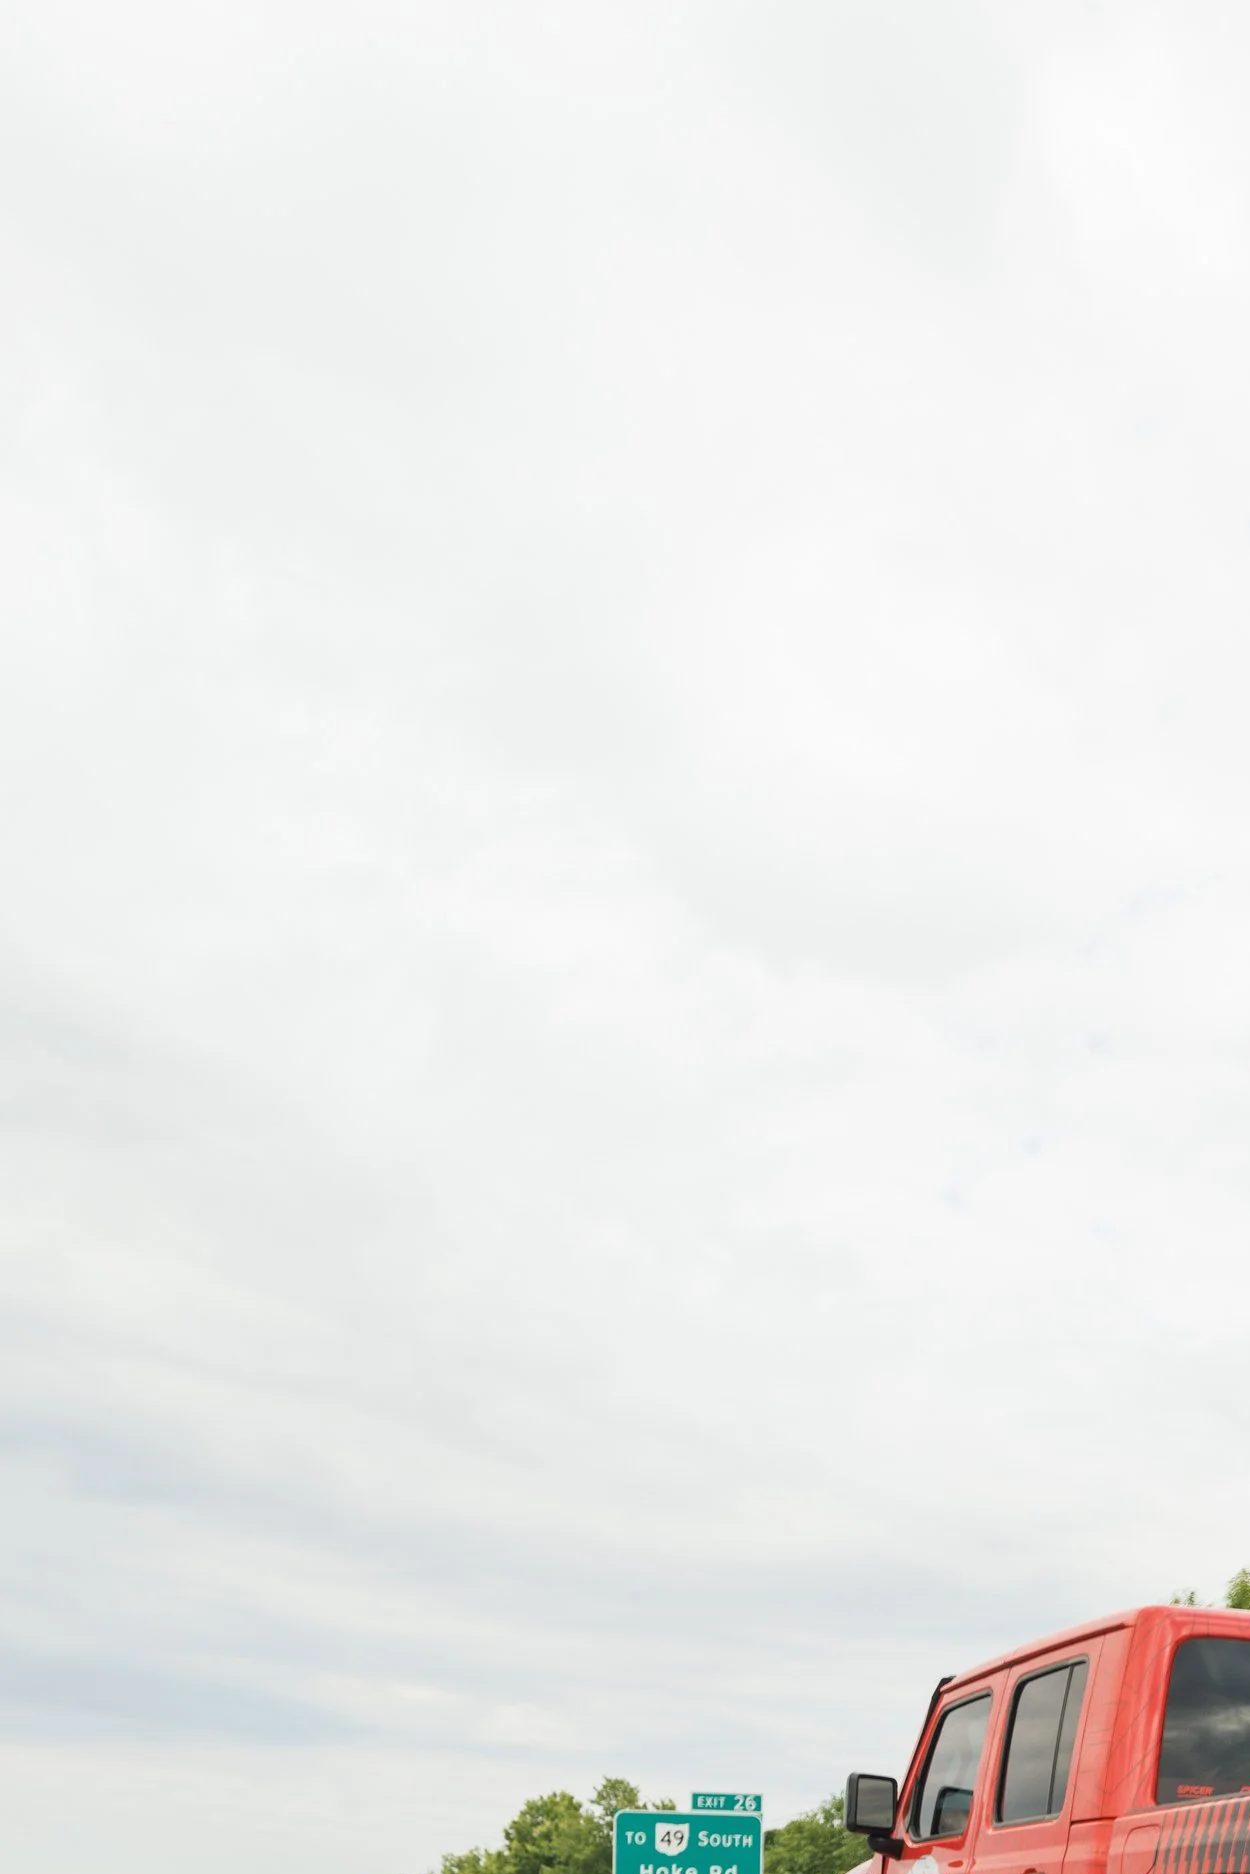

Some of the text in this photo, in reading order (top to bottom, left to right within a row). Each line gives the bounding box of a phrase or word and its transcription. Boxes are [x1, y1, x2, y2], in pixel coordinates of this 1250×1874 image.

[697, 1794, 757, 1811] EXIT 26
[625, 1830, 753, 1848] TO 49 SOUTH
